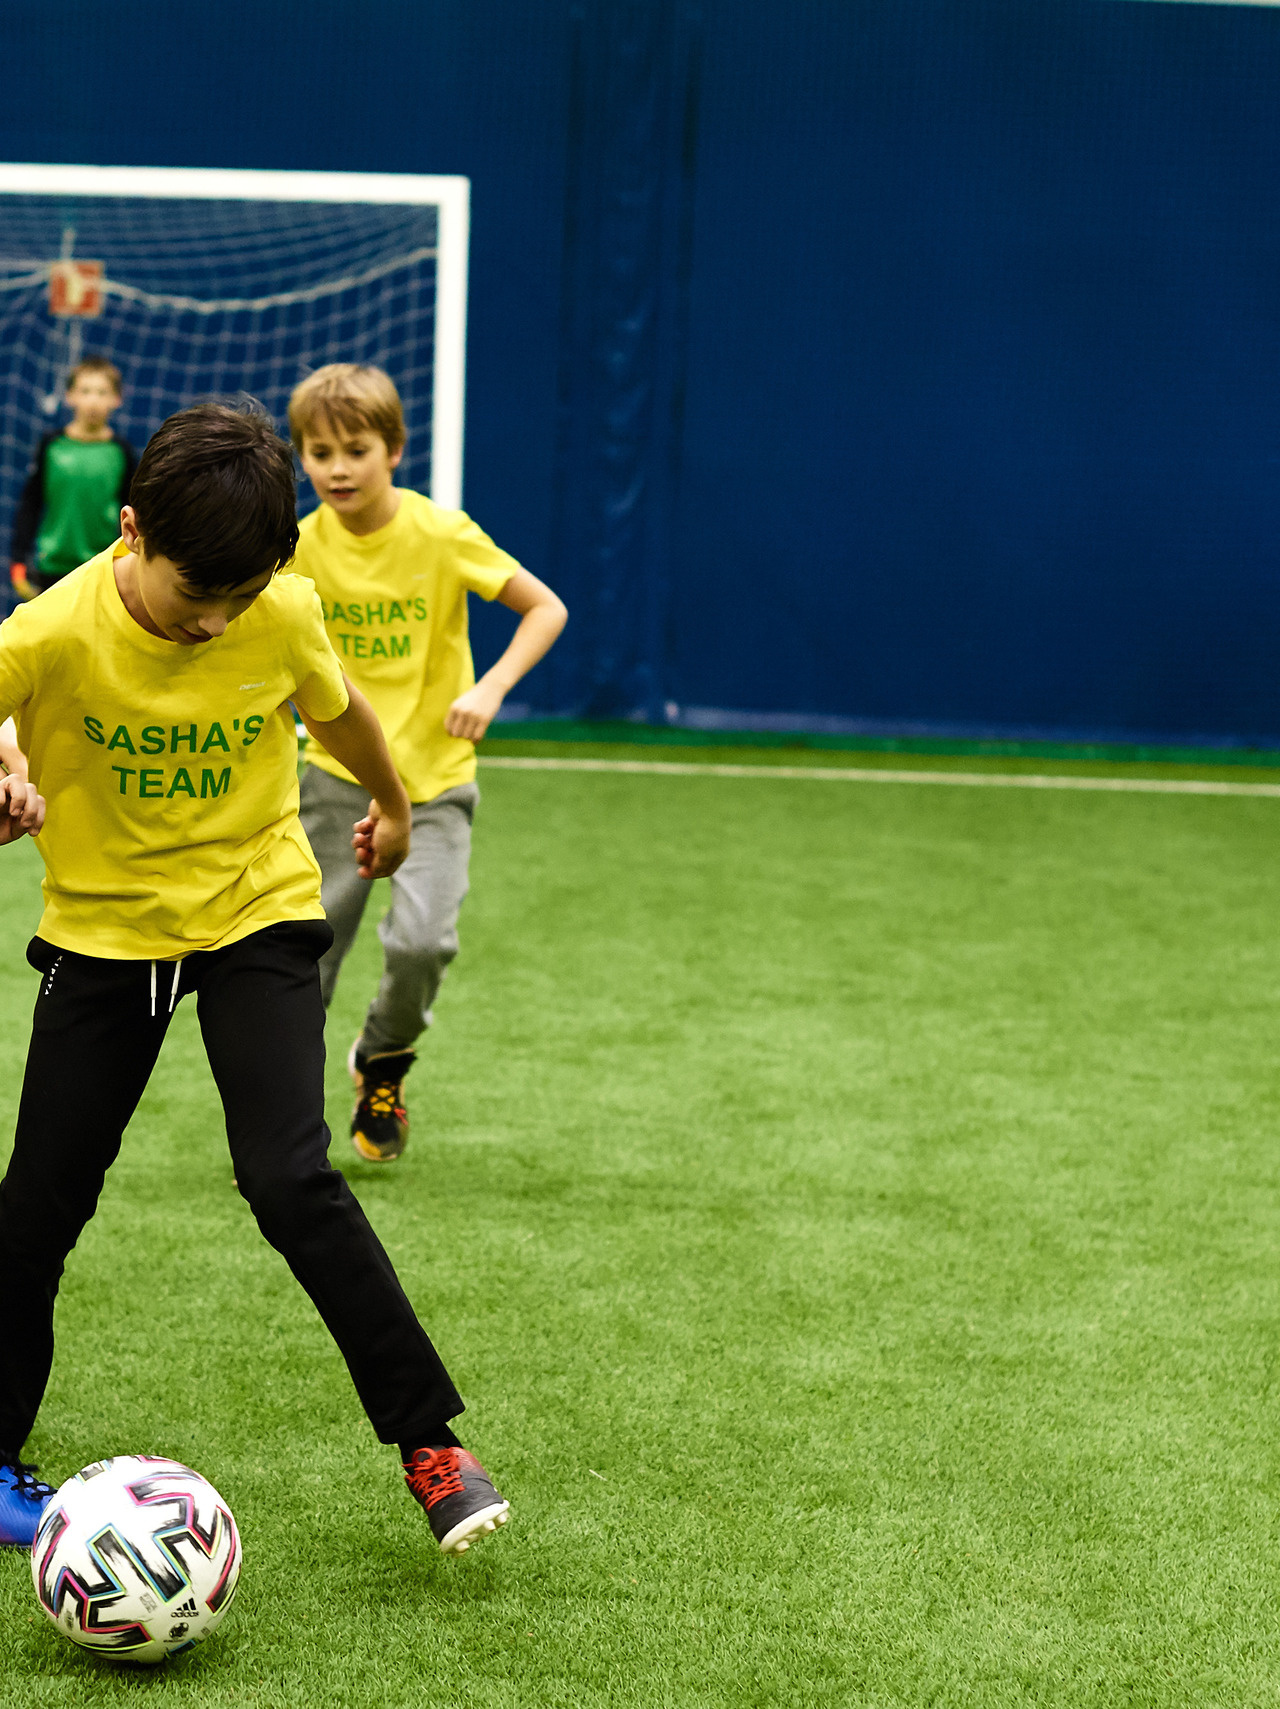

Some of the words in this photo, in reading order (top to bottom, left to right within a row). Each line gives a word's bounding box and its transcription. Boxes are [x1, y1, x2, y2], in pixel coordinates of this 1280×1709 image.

[337, 633, 412, 659] TEAM
[83, 715, 265, 755] SASHA'S
[111, 765, 232, 799] TEAM
